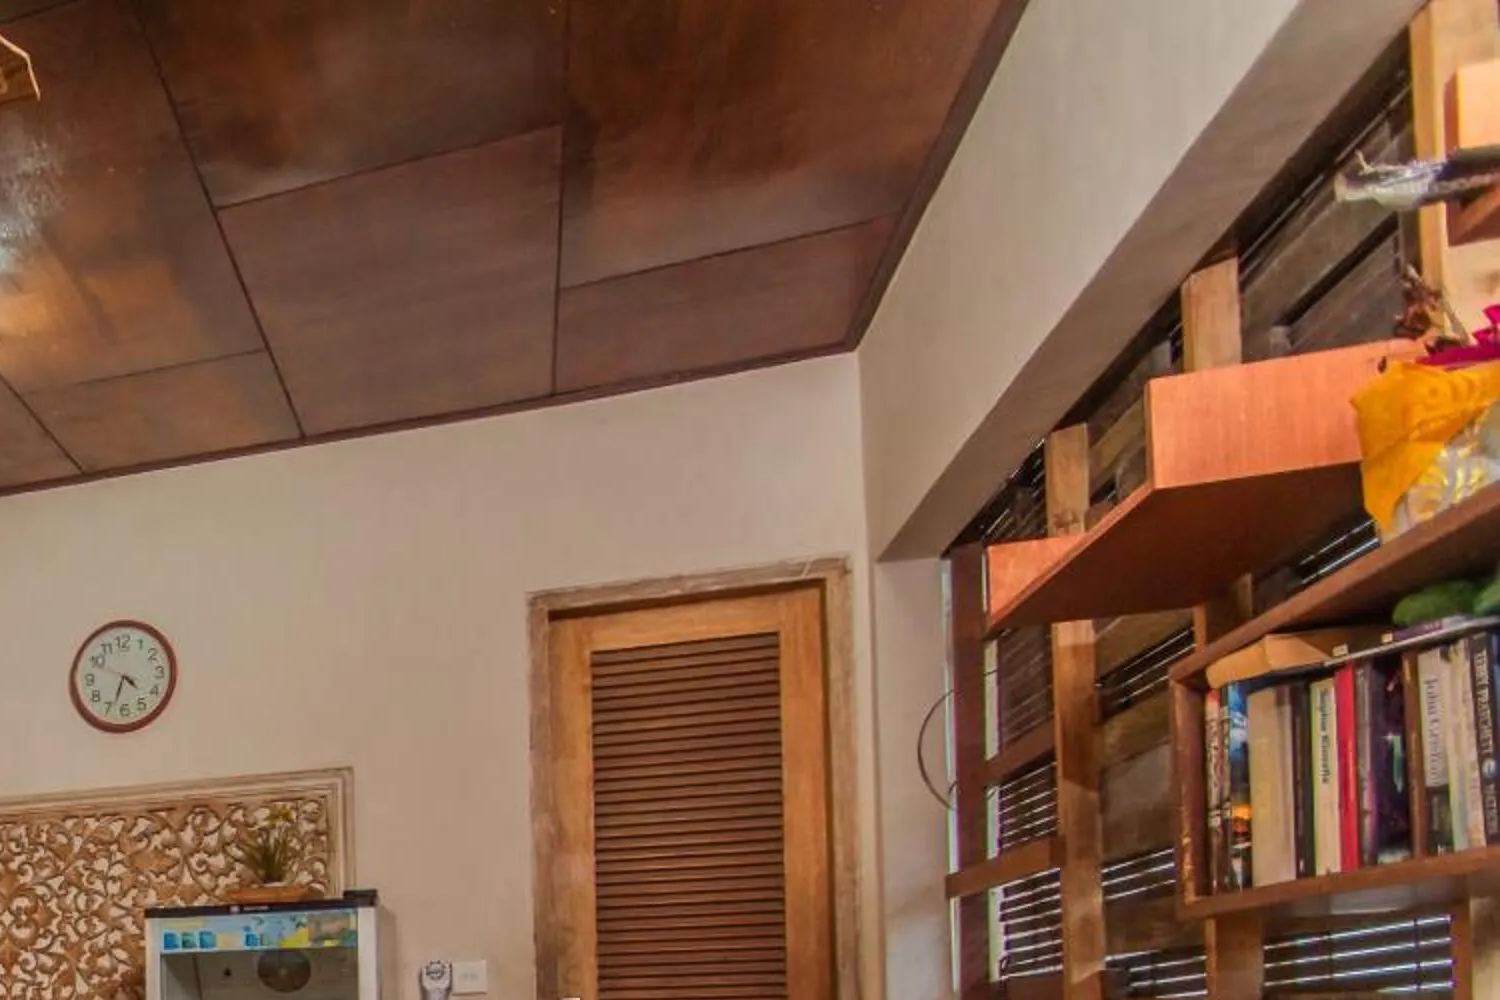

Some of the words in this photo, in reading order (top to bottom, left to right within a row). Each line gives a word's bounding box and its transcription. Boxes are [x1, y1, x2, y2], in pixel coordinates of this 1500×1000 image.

[100, 643, 113, 654] 11
[115, 635, 131, 651] 12
[137, 639, 143, 649] 1
[148, 648, 157, 661] 2
[90, 655, 105, 668] 10
[155, 666, 165, 679] 3
[85, 674, 95, 686] 9
[91, 690, 101, 702] 8
[149, 685, 159, 697] 4
[104, 702, 113, 716] 7
[120, 704, 131, 717] 6
[137, 698, 147, 711] 5
